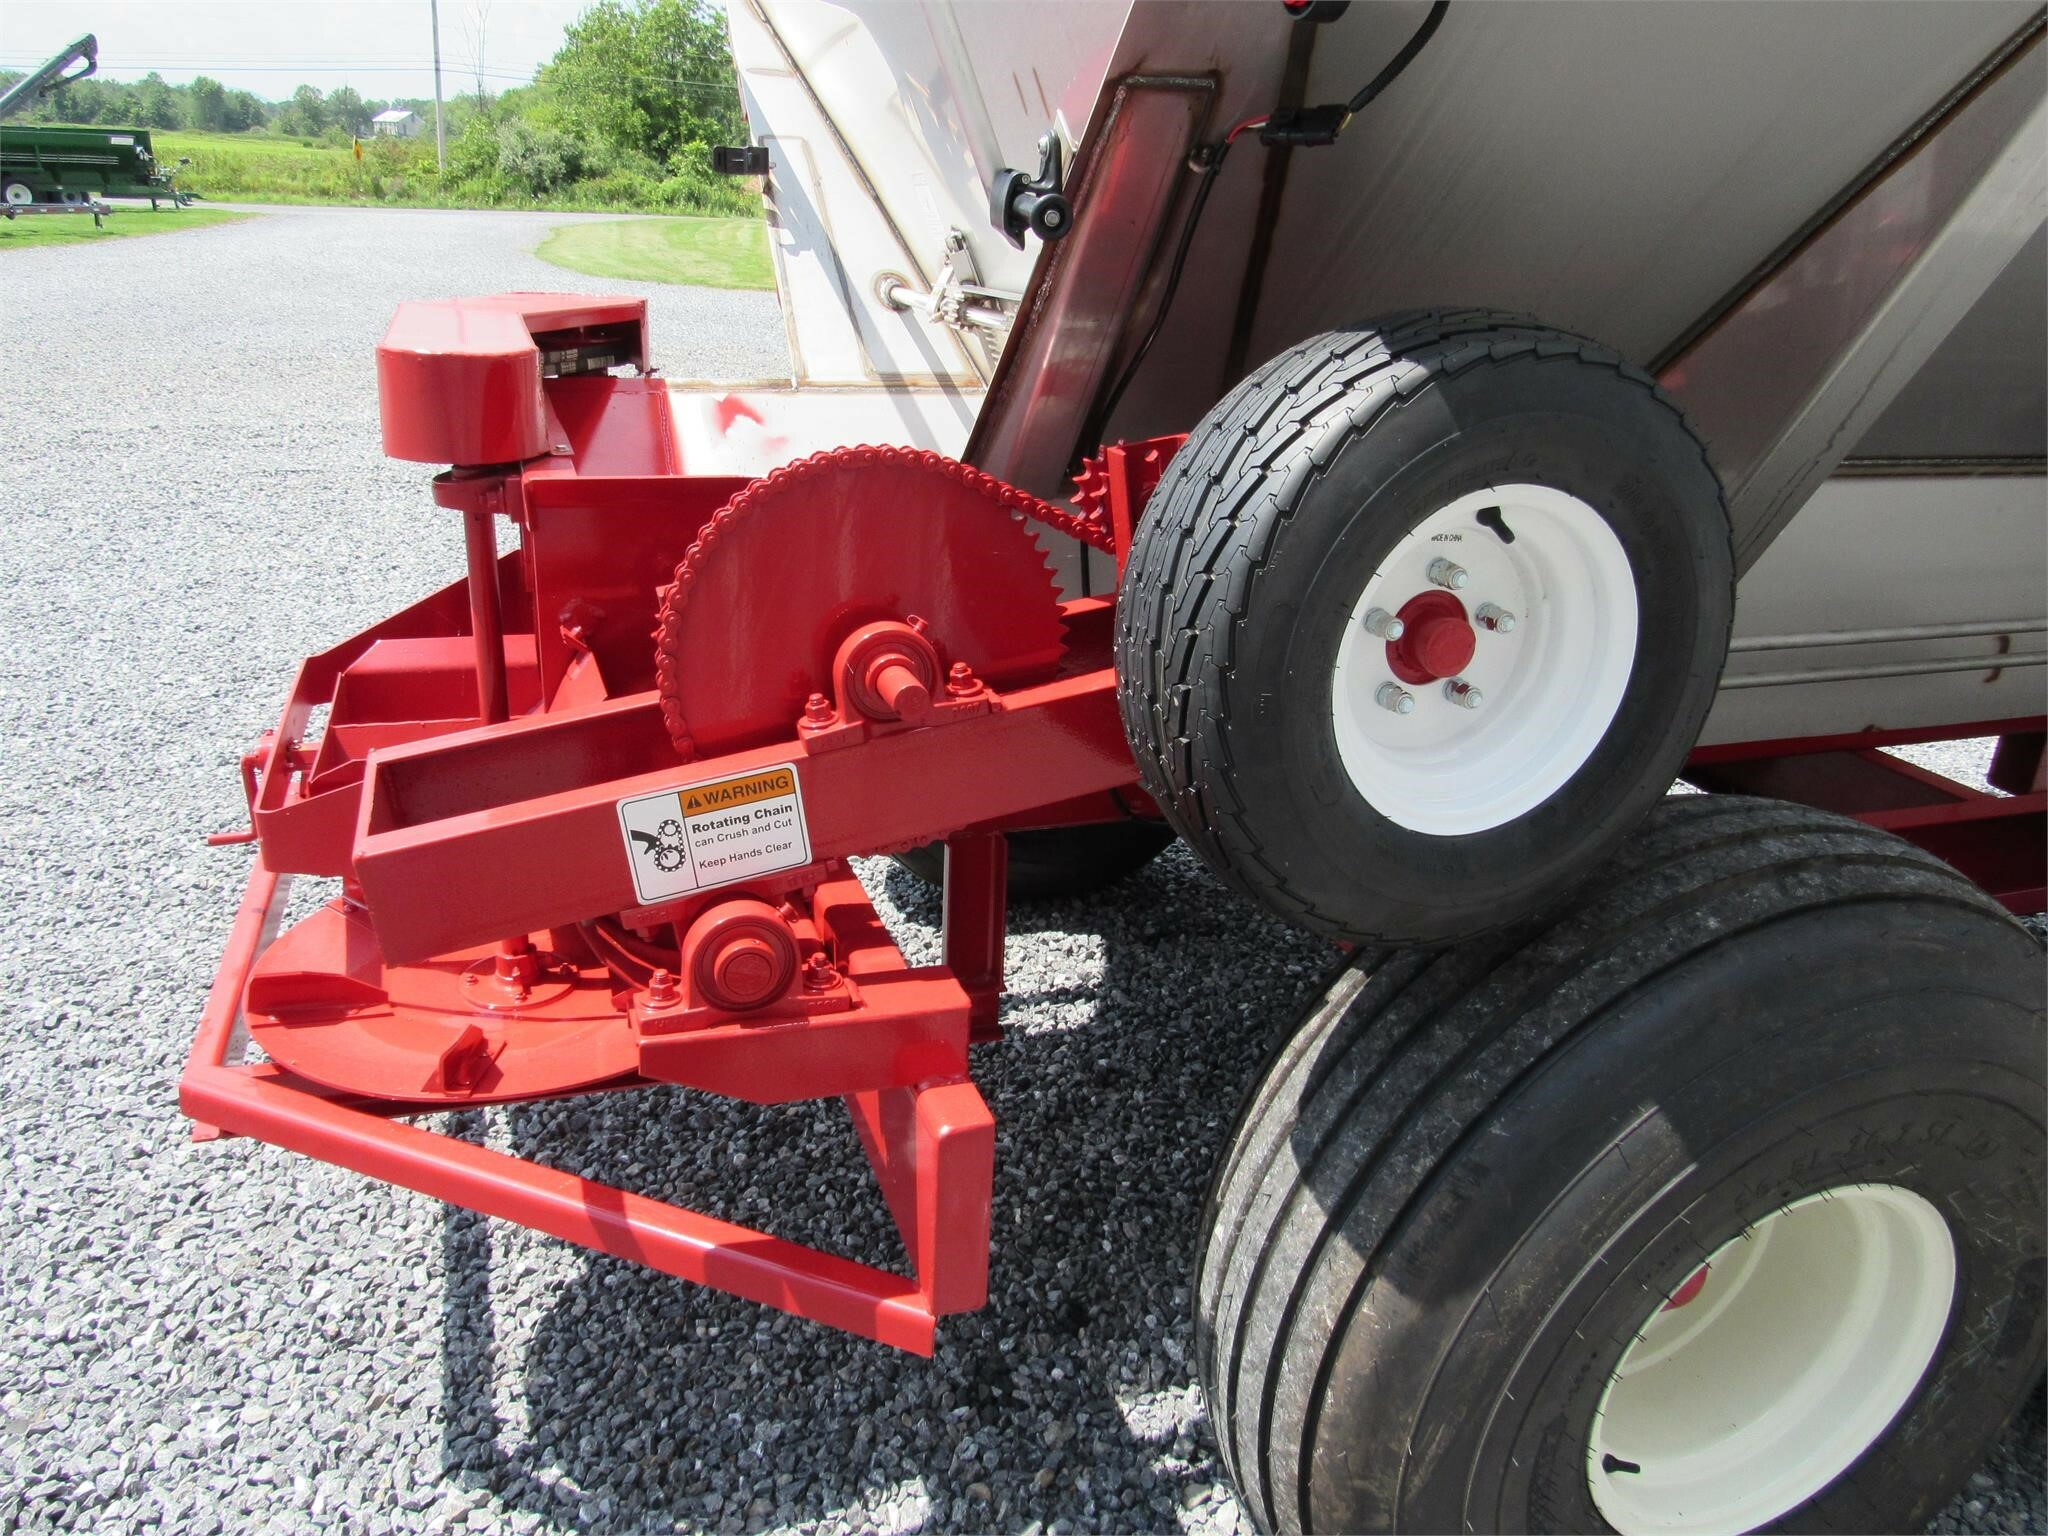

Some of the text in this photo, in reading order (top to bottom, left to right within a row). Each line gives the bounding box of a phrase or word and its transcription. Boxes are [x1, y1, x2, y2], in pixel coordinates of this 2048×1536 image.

[1449, 533, 1463, 542] CHINA
[703, 775, 789, 805] WARNING
[692, 804, 793, 834] Rotating Chain
[694, 818, 793, 848] can Crush and Cut
[699, 841, 793, 870] Keep Hands Clear
